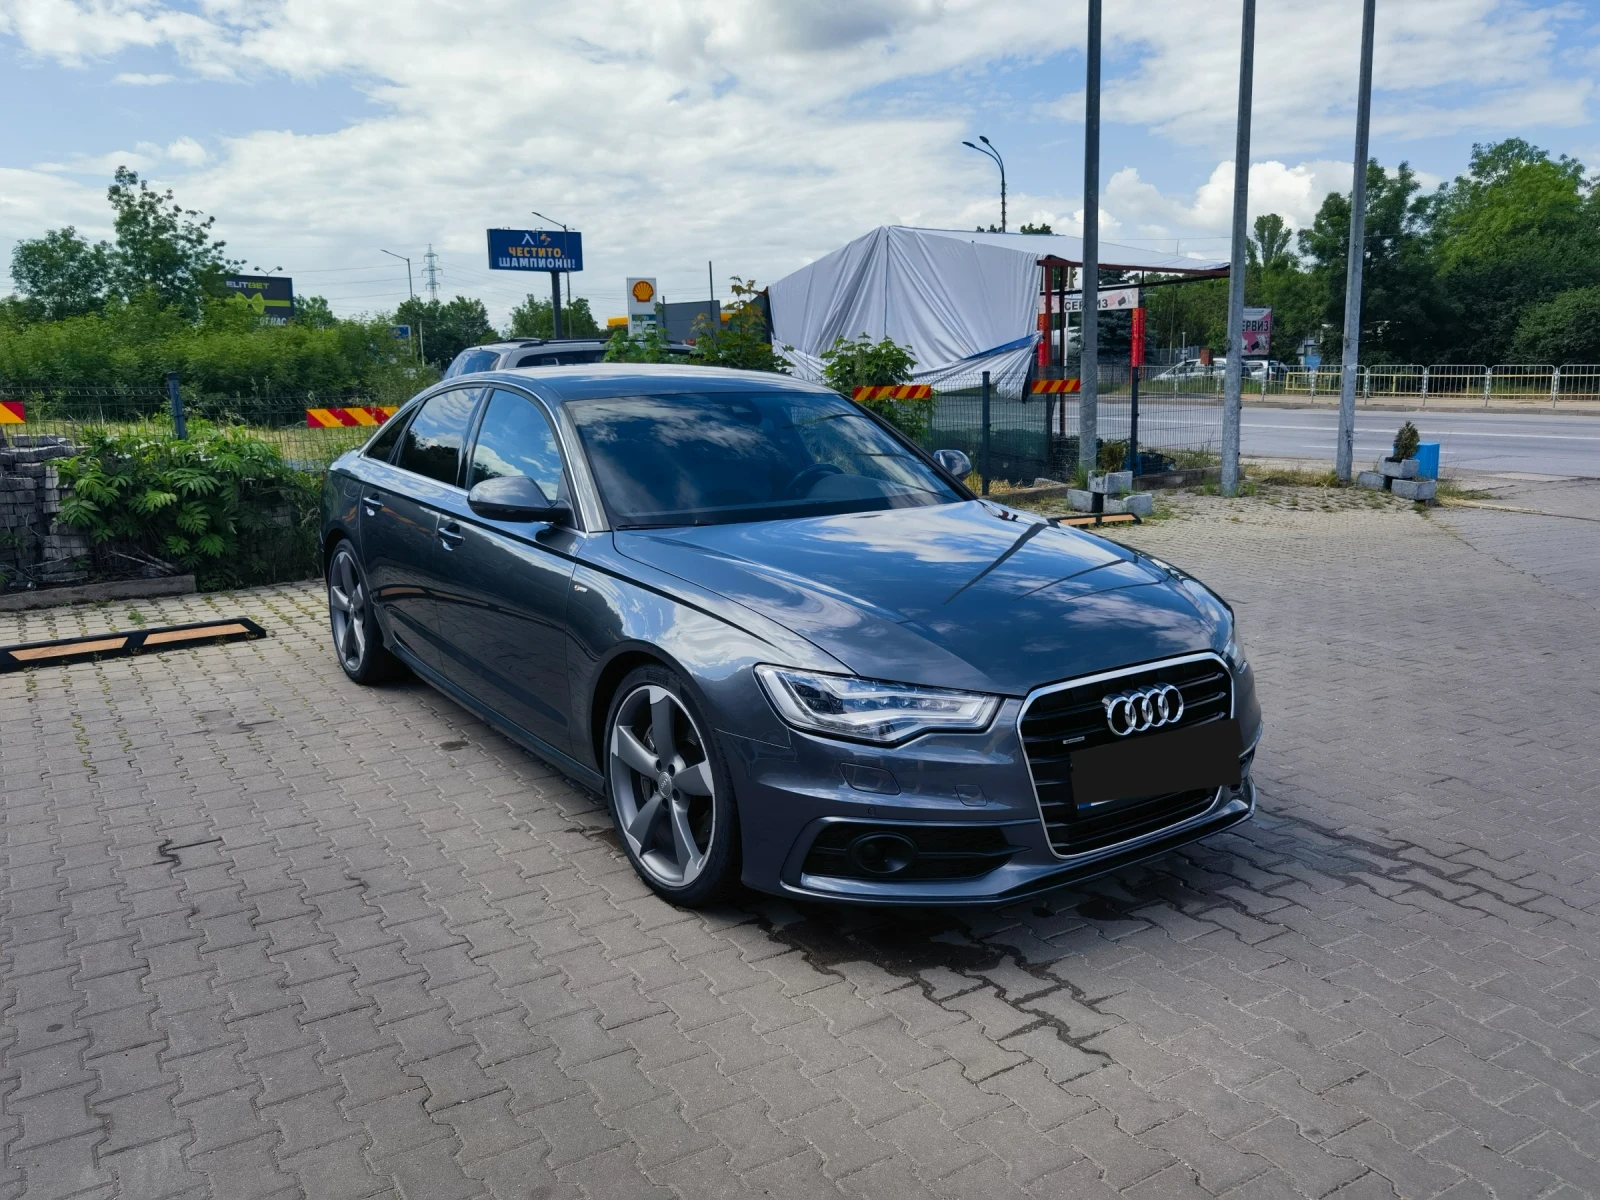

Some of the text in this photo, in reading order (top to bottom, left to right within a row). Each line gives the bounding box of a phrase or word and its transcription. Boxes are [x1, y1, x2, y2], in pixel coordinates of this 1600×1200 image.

[508, 247, 565, 258] ЧЕСТИТО,
[498, 257, 576, 269] ШАМПИОНИ!
[225, 280, 270, 289] ELITBET
[1242, 320, 1269, 332] ЕРВИЗ
